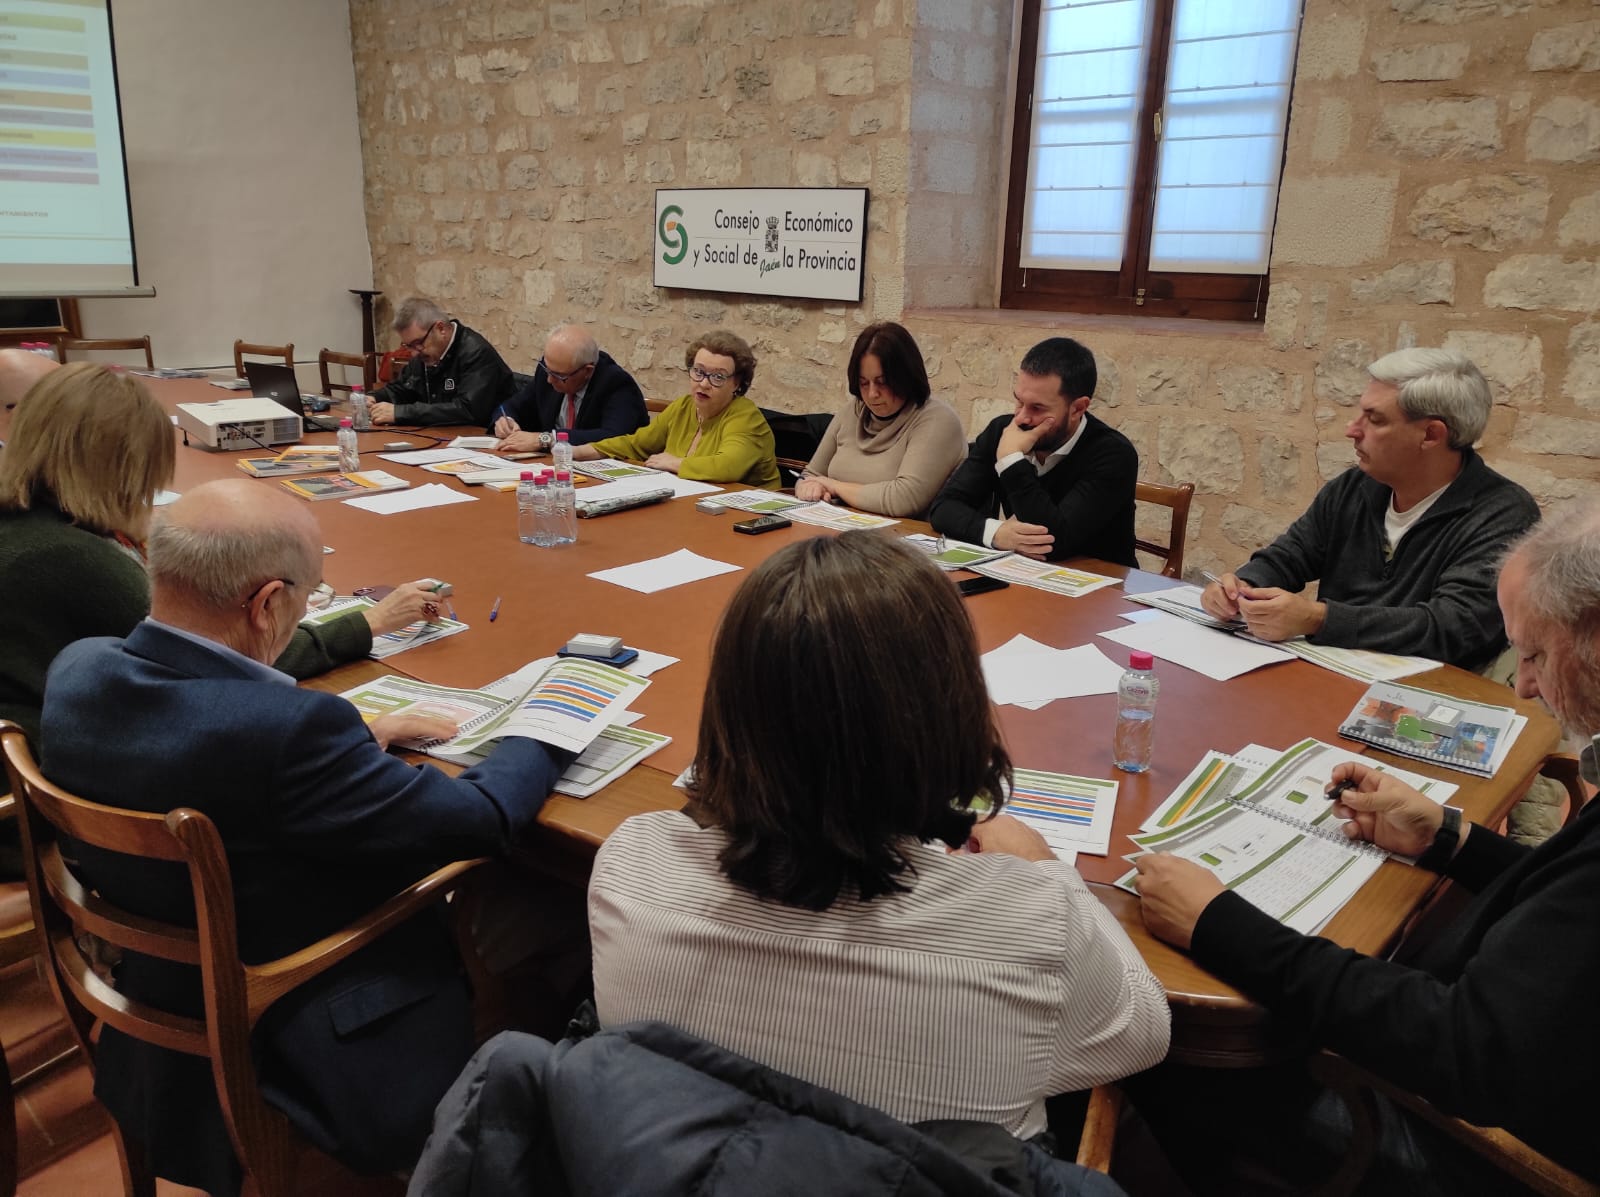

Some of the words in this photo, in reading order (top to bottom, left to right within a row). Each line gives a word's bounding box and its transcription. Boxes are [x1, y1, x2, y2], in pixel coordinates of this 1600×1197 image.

[714, 208, 760, 235] Consejo
[784, 210, 853, 232] Económico
[693, 249, 700, 268] y
[704, 242, 739, 264] Social
[743, 243, 758, 265] de
[782, 245, 794, 268] la
[798, 248, 856, 271] Provincia
